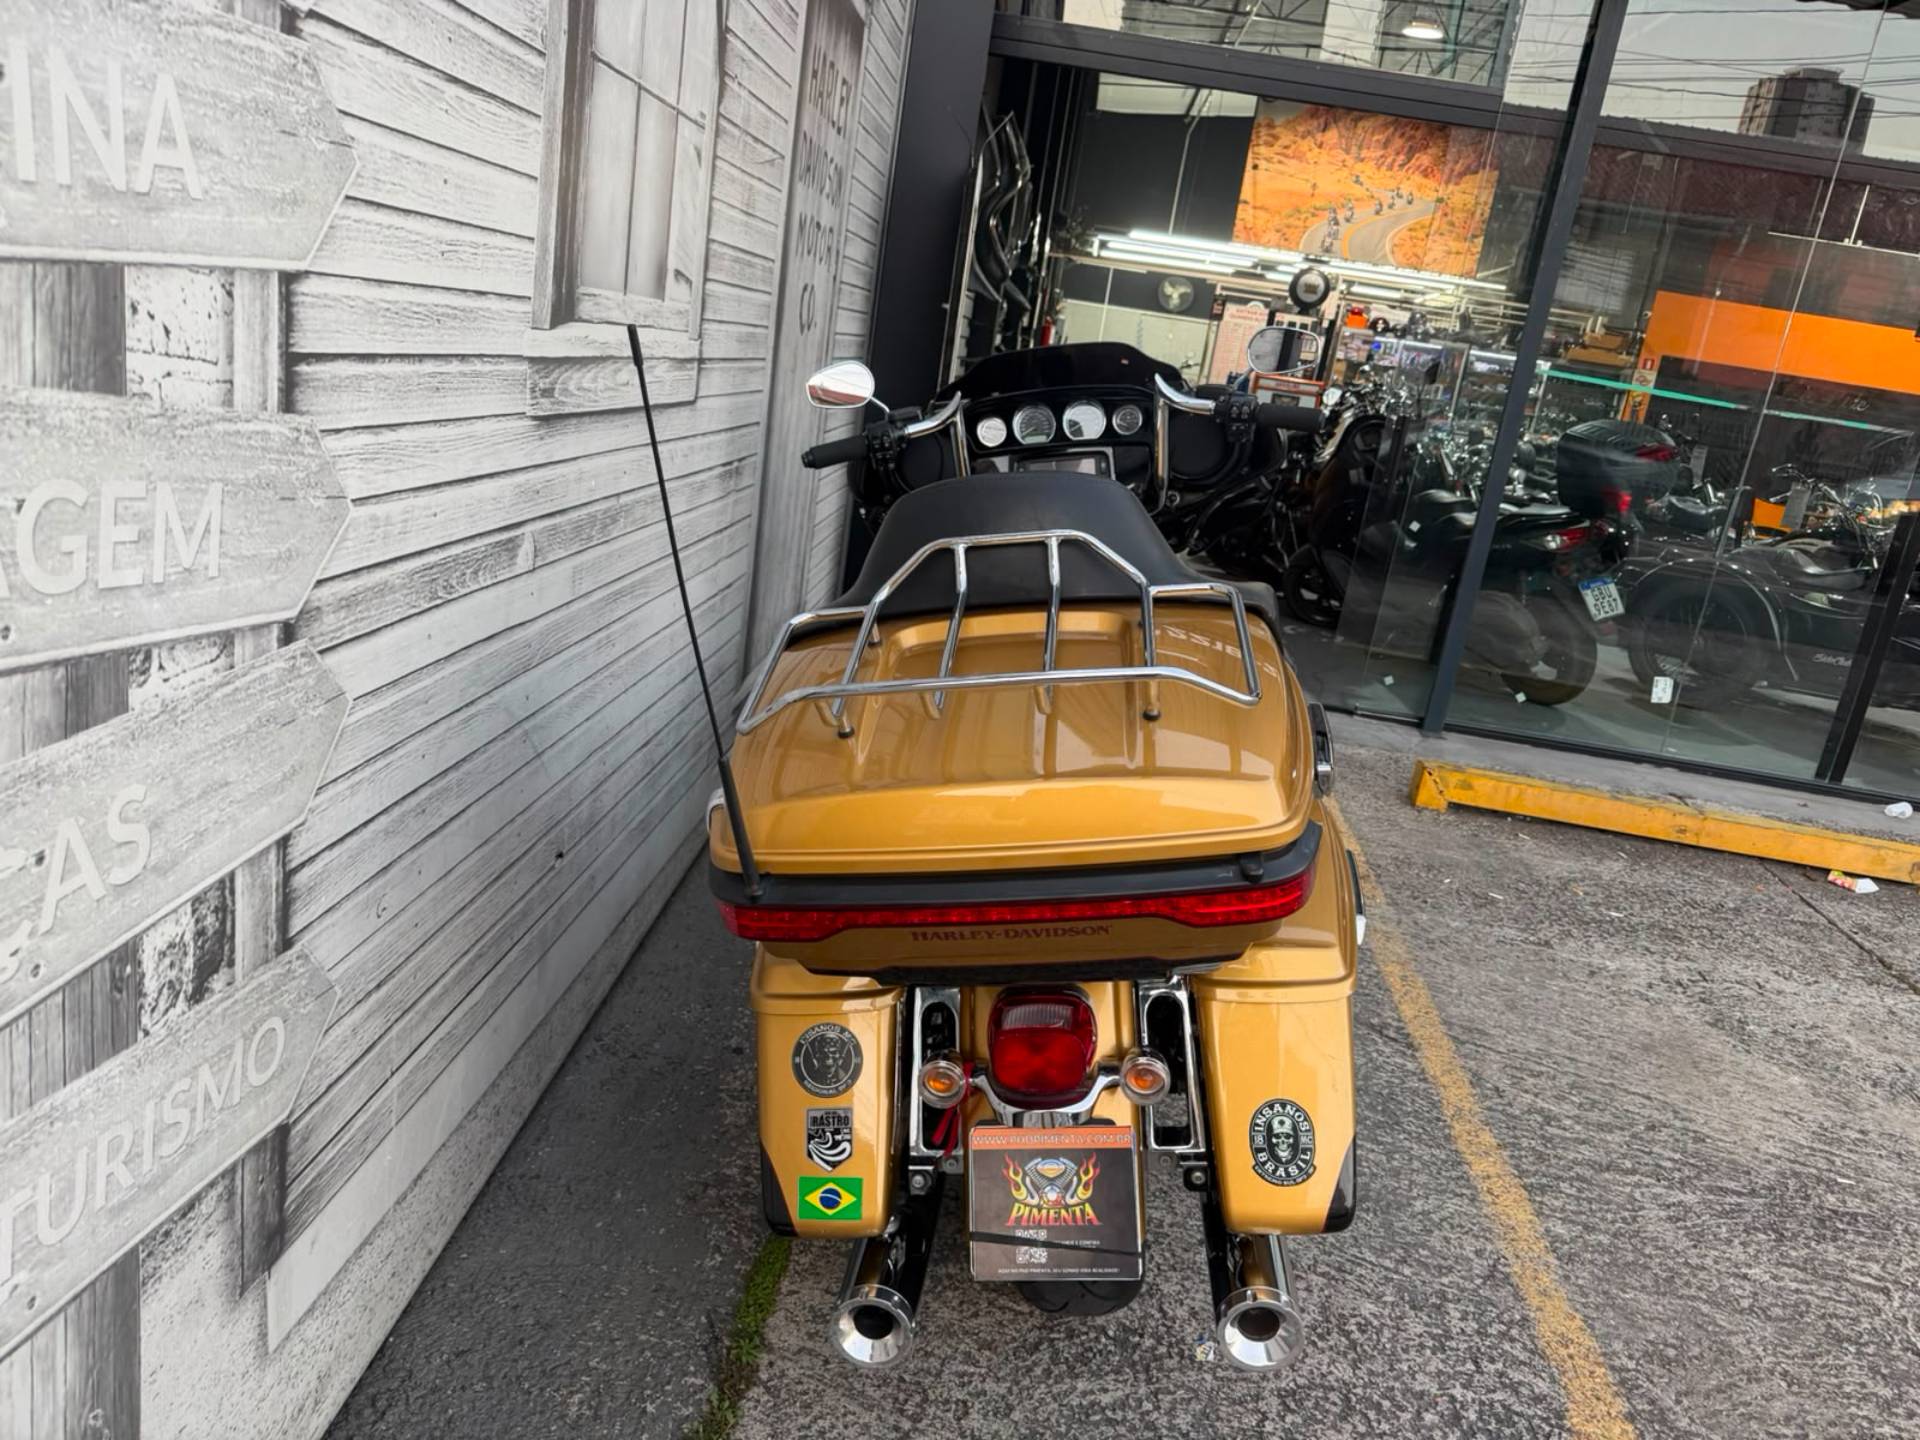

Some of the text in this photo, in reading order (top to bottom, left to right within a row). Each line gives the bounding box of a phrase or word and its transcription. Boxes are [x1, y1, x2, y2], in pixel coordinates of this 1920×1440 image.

[808, 43, 852, 139] HARLEY
[795, 212, 834, 272] MOTOR
[0, 478, 224, 598] GEM
[911, 925, 1110, 942] HARLEY-DAVIDSON
[810, 1114, 850, 1127] RASTRO
[1254, 1103, 1310, 1131] INSANOS
[1257, 1151, 1311, 1177] BRASIL
[1005, 1202, 1103, 1227] PIMENTA
